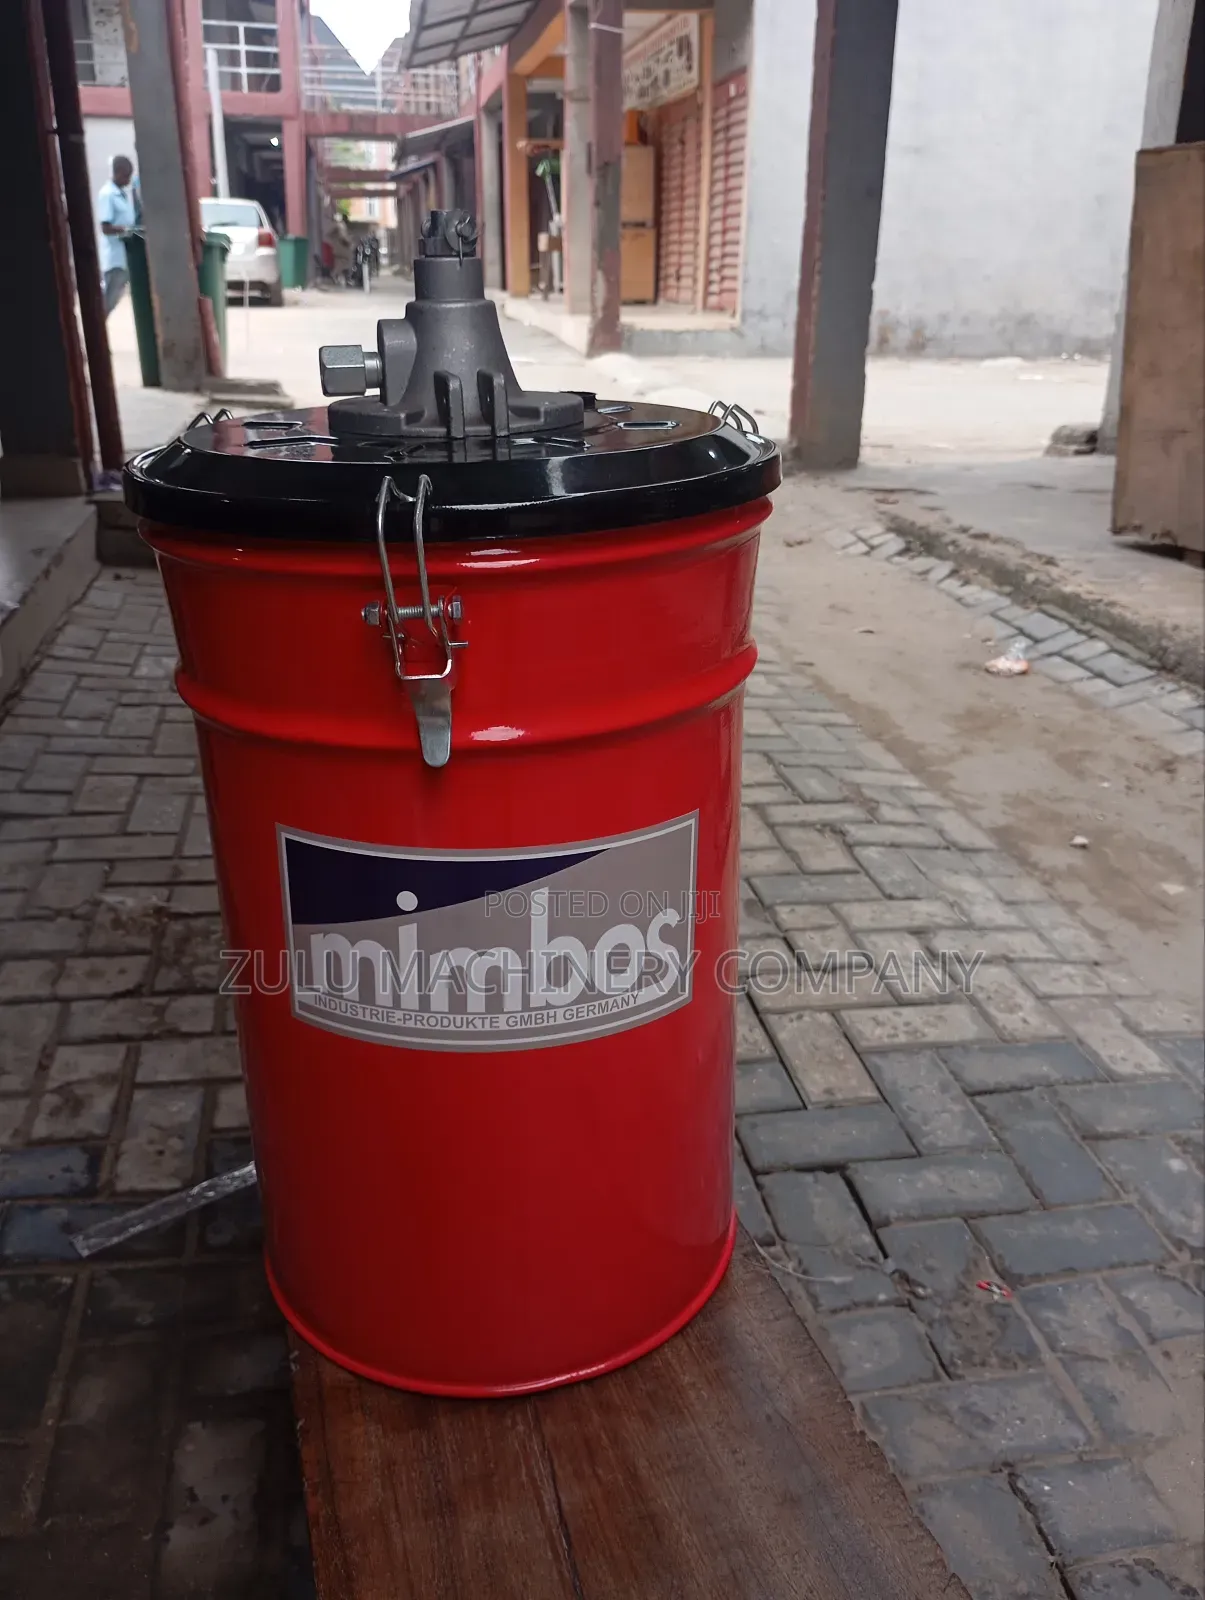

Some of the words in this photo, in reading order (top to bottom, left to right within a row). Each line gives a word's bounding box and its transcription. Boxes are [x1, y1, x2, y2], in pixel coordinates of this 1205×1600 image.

[311, 886, 680, 1013] mimbos
[314, 994, 500, 1029] INDUSTRIE-PRODUKTE
[505, 1011, 557, 1028] GMBH
[562, 992, 641, 1020] GERMANY
